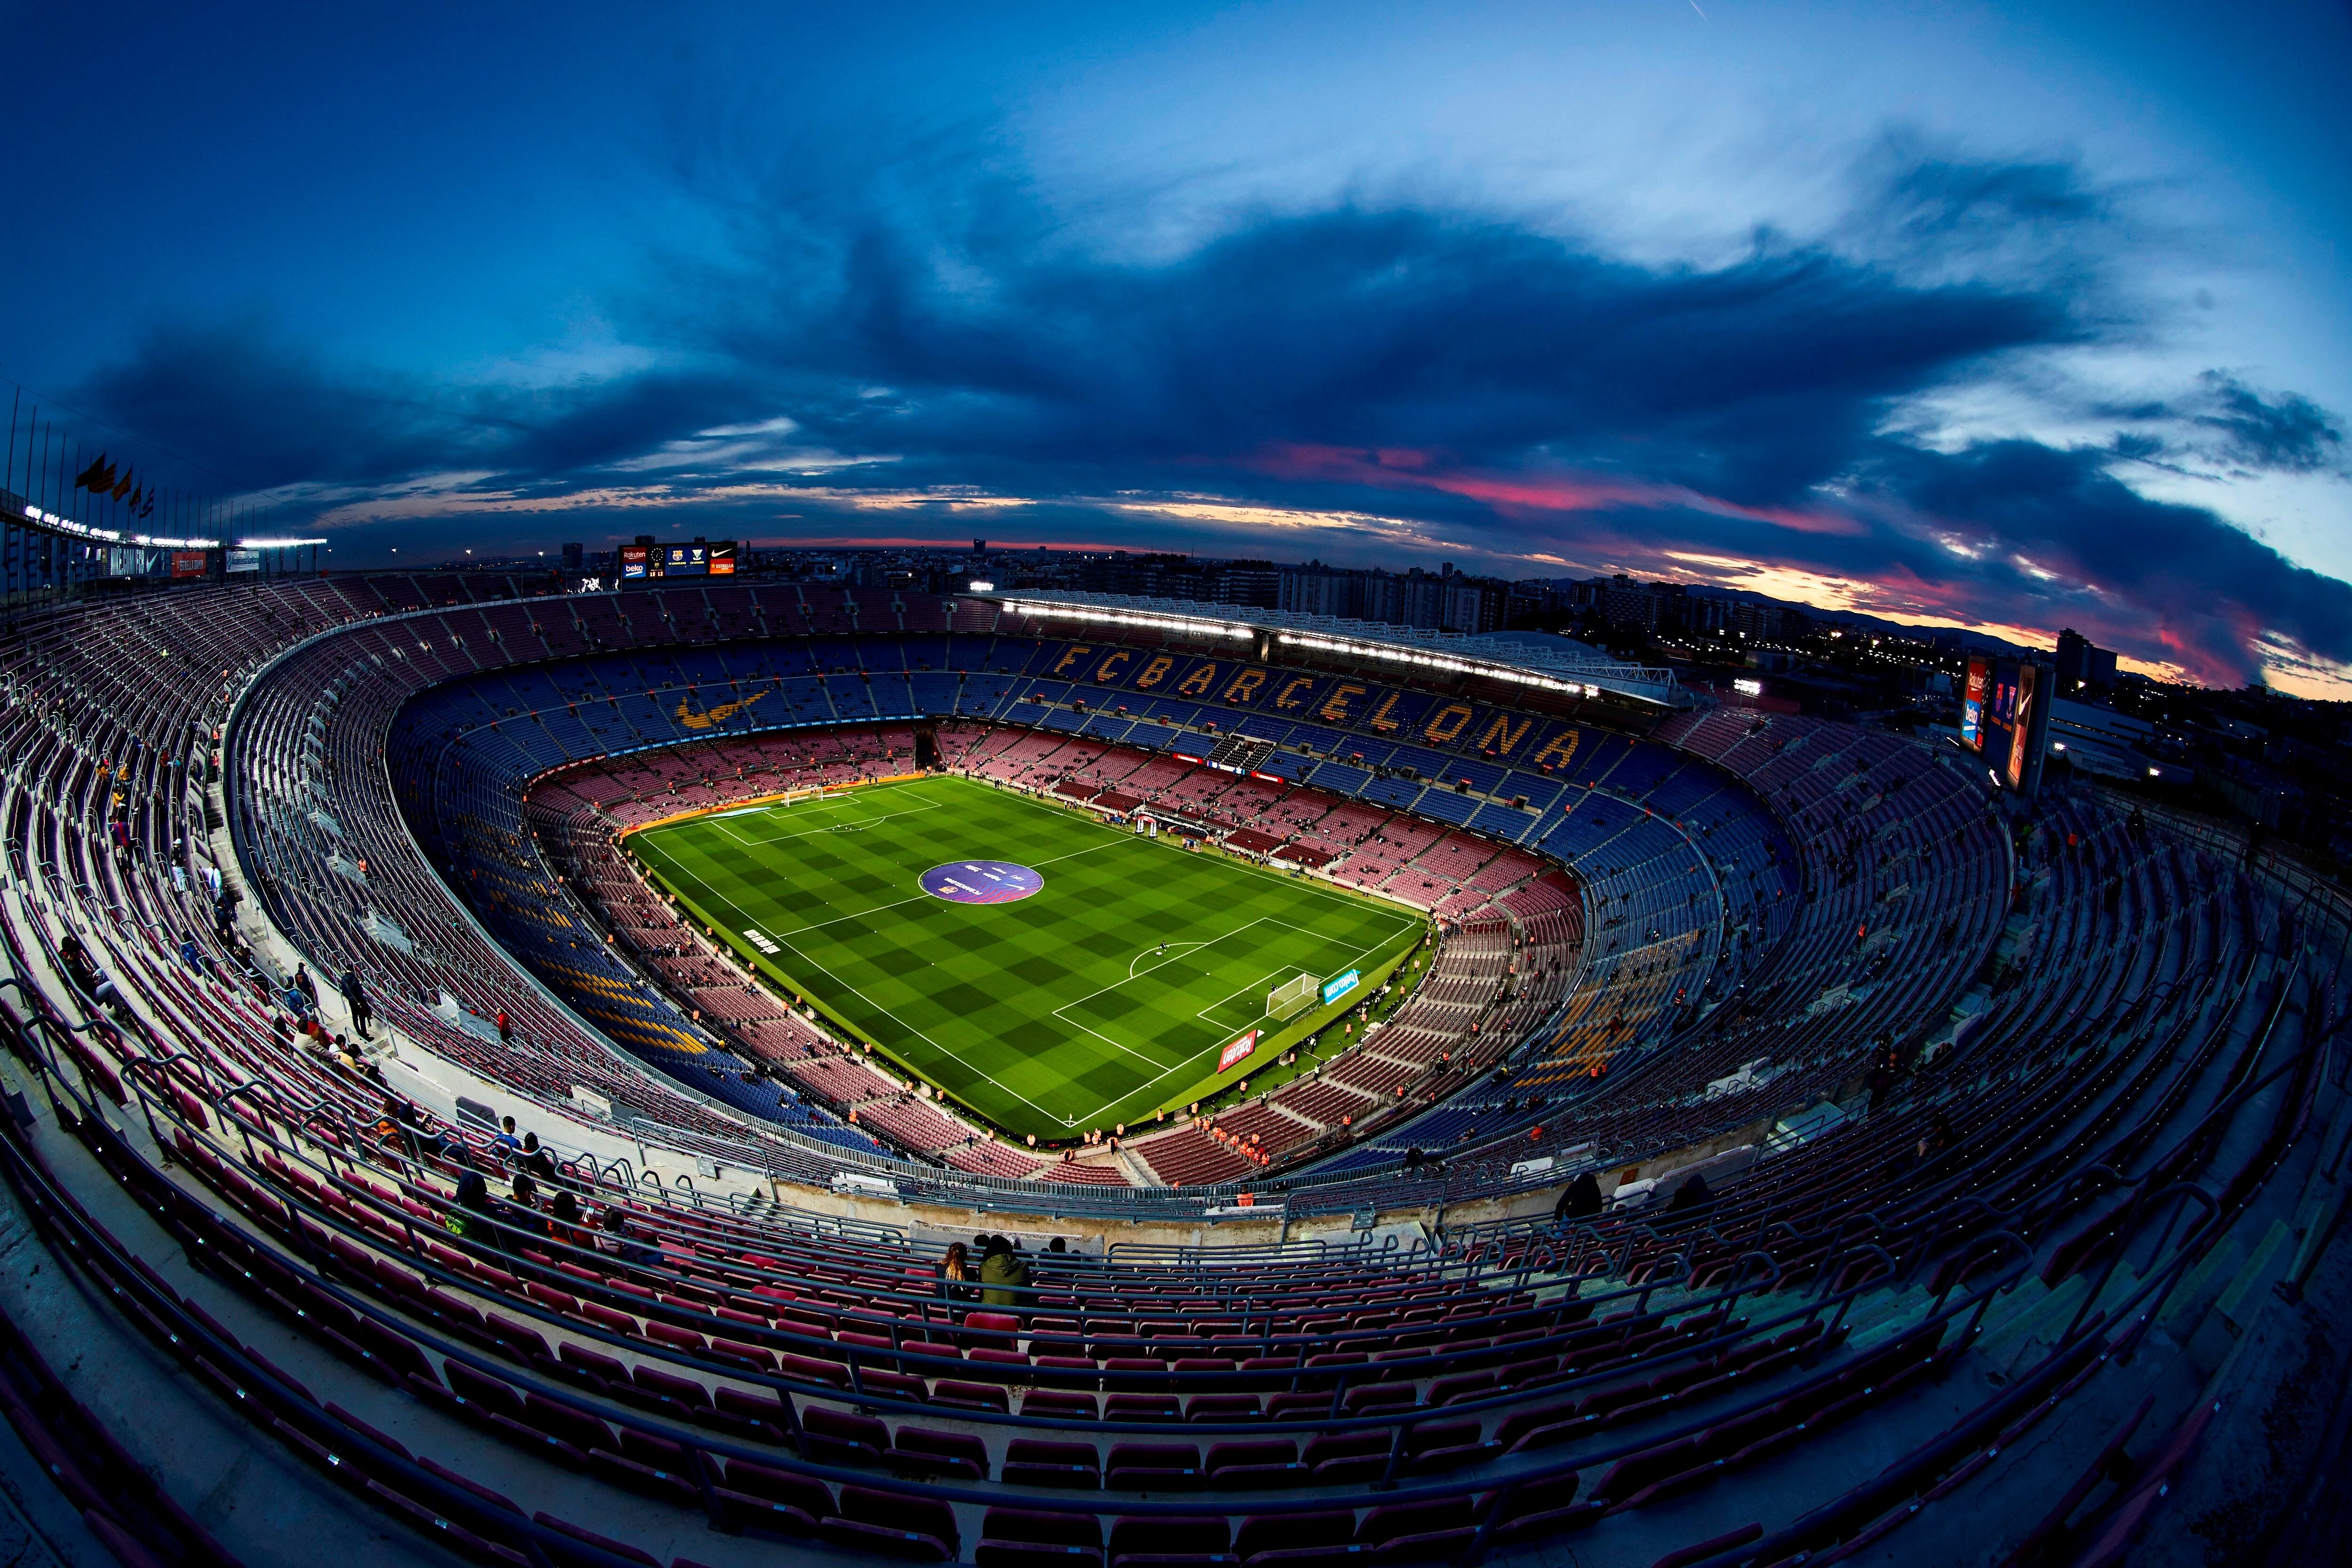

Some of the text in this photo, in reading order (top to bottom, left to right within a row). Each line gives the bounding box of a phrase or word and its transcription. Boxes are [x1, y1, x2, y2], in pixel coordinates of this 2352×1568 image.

[1970, 672, 1984, 689] Rakuten
[1966, 704, 1978, 724] beko
[944, 878, 973, 893] BARCELONA
[1325, 972, 1356, 998] beko.com
[1223, 1036, 1253, 1065] Rakuten
